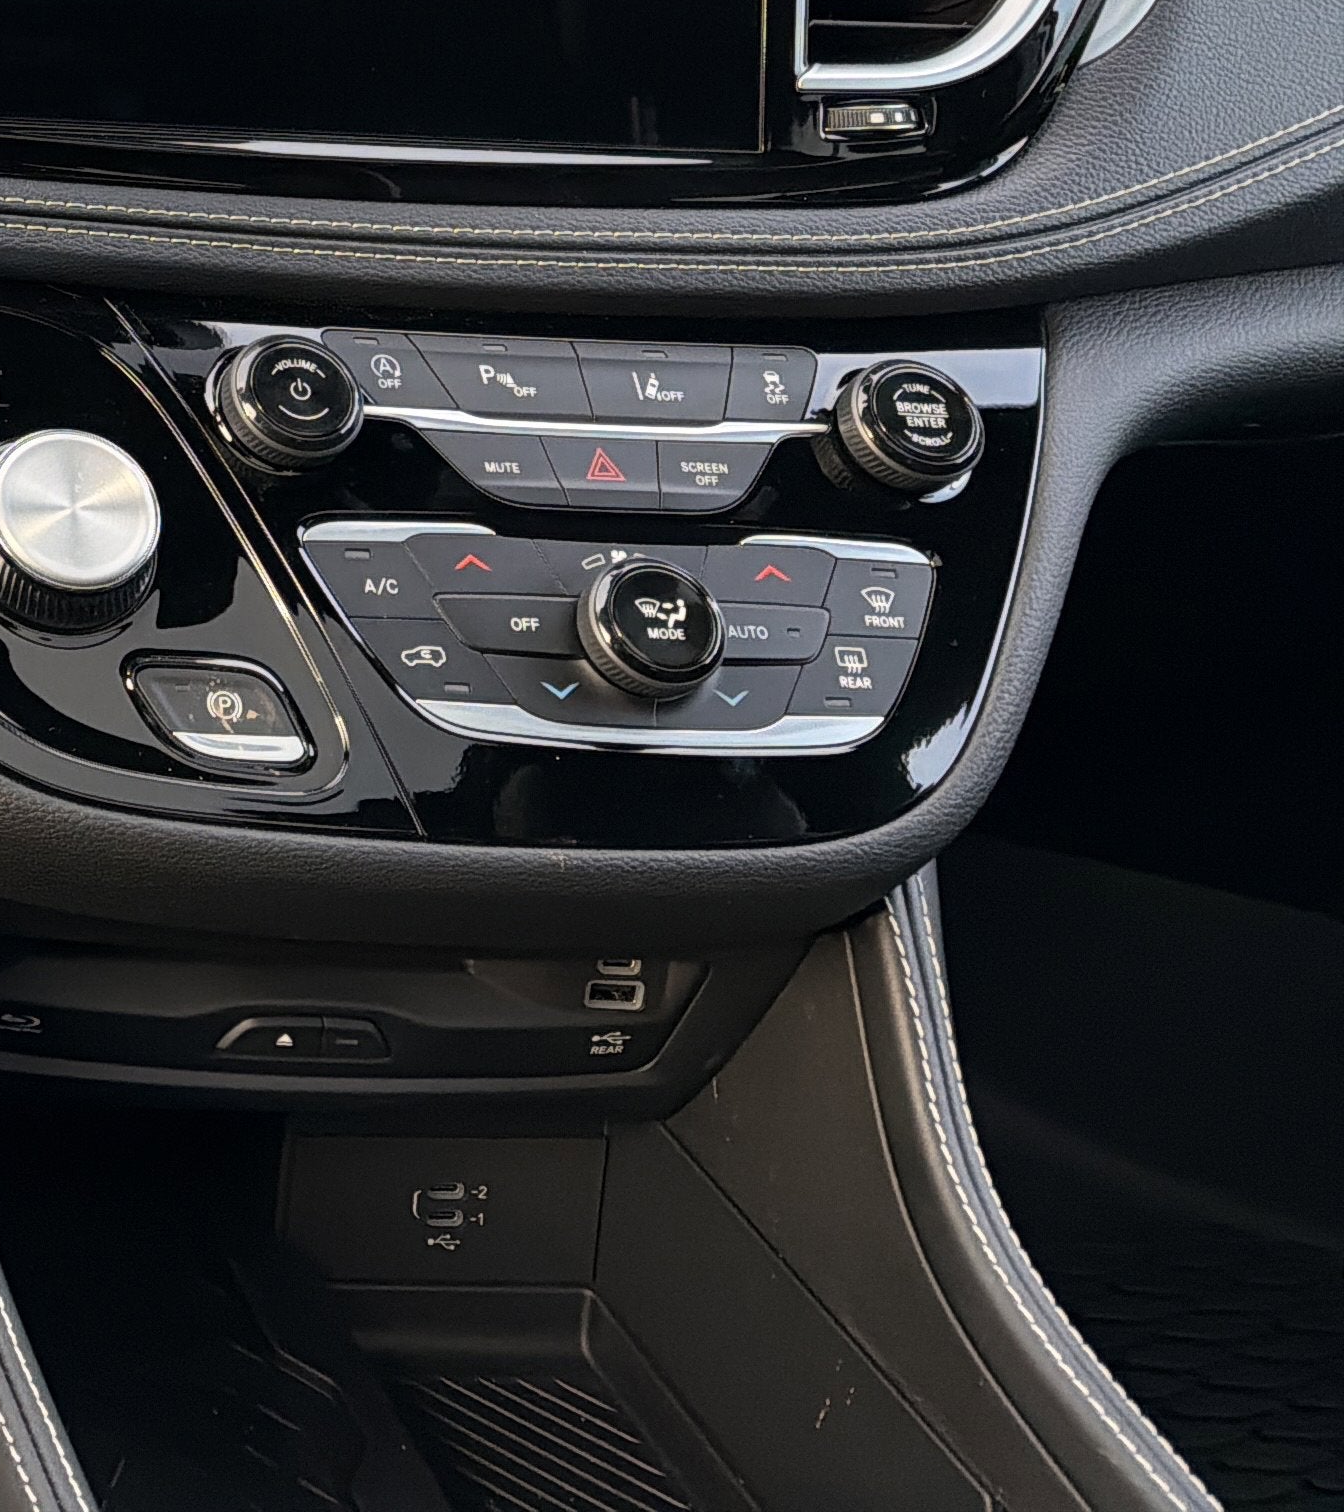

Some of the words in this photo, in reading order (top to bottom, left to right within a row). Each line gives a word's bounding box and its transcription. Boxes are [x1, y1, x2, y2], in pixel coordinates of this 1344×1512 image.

[276, 359, 317, 375] VOLUME
[378, 377, 402, 390] OFF
[902, 383, 931, 395] TUNE
[513, 385, 538, 399] OFF
[660, 389, 685, 403] OFF
[766, 393, 790, 406] OFF
[895, 401, 948, 415] BROWSE
[906, 416, 947, 429] ENTER
[912, 434, 952, 447] SCROLL
[484, 460, 521, 475] MUTE
[680, 460, 729, 476] SCREEN
[694, 473, 719, 487] OFF
[364, 578, 399, 596] A/C
[510, 617, 540, 632] OFF
[863, 614, 905, 629] FRONT
[646, 627, 686, 641] MODE
[727, 625, 769, 640] AUTO
[839, 675, 872, 690] REAR
[589, 1045, 624, 1055] REAR
